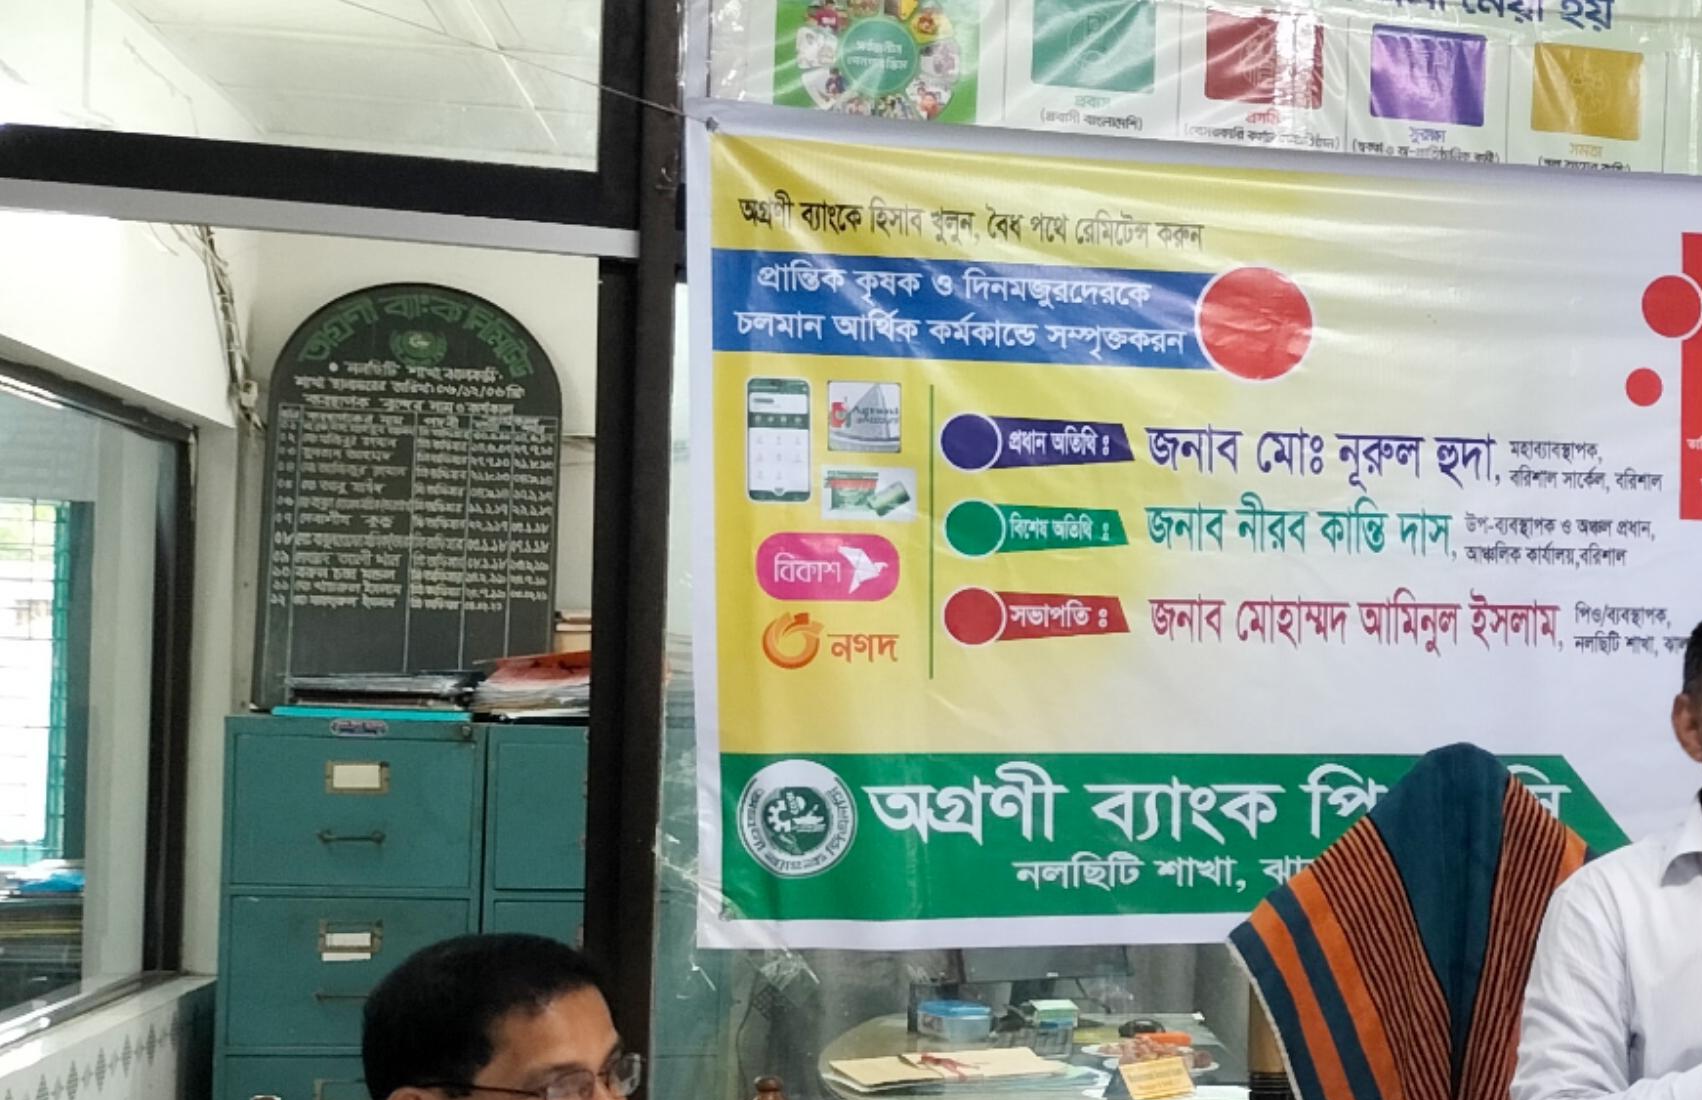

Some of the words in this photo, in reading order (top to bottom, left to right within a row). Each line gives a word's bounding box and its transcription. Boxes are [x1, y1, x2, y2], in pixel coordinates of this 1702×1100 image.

[739, 194, 793, 230] অগ্রণী
[800, 203, 863, 235] ব্যাংকে
[870, 201, 922, 237] হিসাব
[932, 211, 980, 246] খুলুন,
[987, 205, 1023, 240] বৈধ
[1030, 214, 1070, 244] পথে
[1074, 210, 1152, 248] রেমিটেন্স
[1157, 222, 1206, 252] করুন
[757, 259, 846, 291] প্রান্তিক
[854, 270, 922, 307] কৃষক
[932, 275, 954, 297] ও
[962, 268, 1153, 308] দিনমজুরদেরকে
[733, 309, 824, 340] চলমান
[831, 308, 920, 343] আর্থিক
[1008, 429, 1047, 456] প্রধান
[1050, 425, 1098, 456] অতিথি
[1144, 424, 1243, 474] জনাব
[1255, 429, 1324, 477] মোঃ
[1335, 432, 1425, 493] নূরুল
[1434, 433, 1501, 490] হুদা,
[1509, 464, 1558, 489] বরিশাল
[1561, 466, 1610, 494] সার্কেল,
[1614, 467, 1663, 492] বরিশাল
[1009, 511, 1048, 540] বিশেষ
[1052, 512, 1093, 541] অতিথি
[1144, 502, 1227, 553] জনাব
[1235, 490, 1308, 556] নীরব
[1318, 496, 1389, 557] কান্তি
[1396, 510, 1458, 562] দাস,
[1463, 511, 1557, 540] উপ-ব্যবস্থাপক
[1560, 519, 1572, 535] ও
[1616, 518, 1656, 541] প্রধান,
[773, 552, 842, 583] বিকাশ
[1464, 540, 1522, 565] আঞ্চলিক
[1009, 599, 1092, 628] সভাপতি
[1148, 593, 1226, 642] জনাব
[1236, 595, 1350, 648] মোহাম্মদ
[1358, 588, 1462, 657] আমিনুল
[1468, 587, 1563, 651] ইসলাম,
[827, 634, 900, 663] নগদ
[1574, 631, 1621, 656] নলছিটি
[1625, 636, 1659, 657] শাখা,
[861, 760, 1070, 846] অগ্রণী
[1083, 774, 1287, 845] ব্যাংক
[1012, 851, 1145, 891] নলছিটি
[1153, 856, 1248, 893] শাখা,
